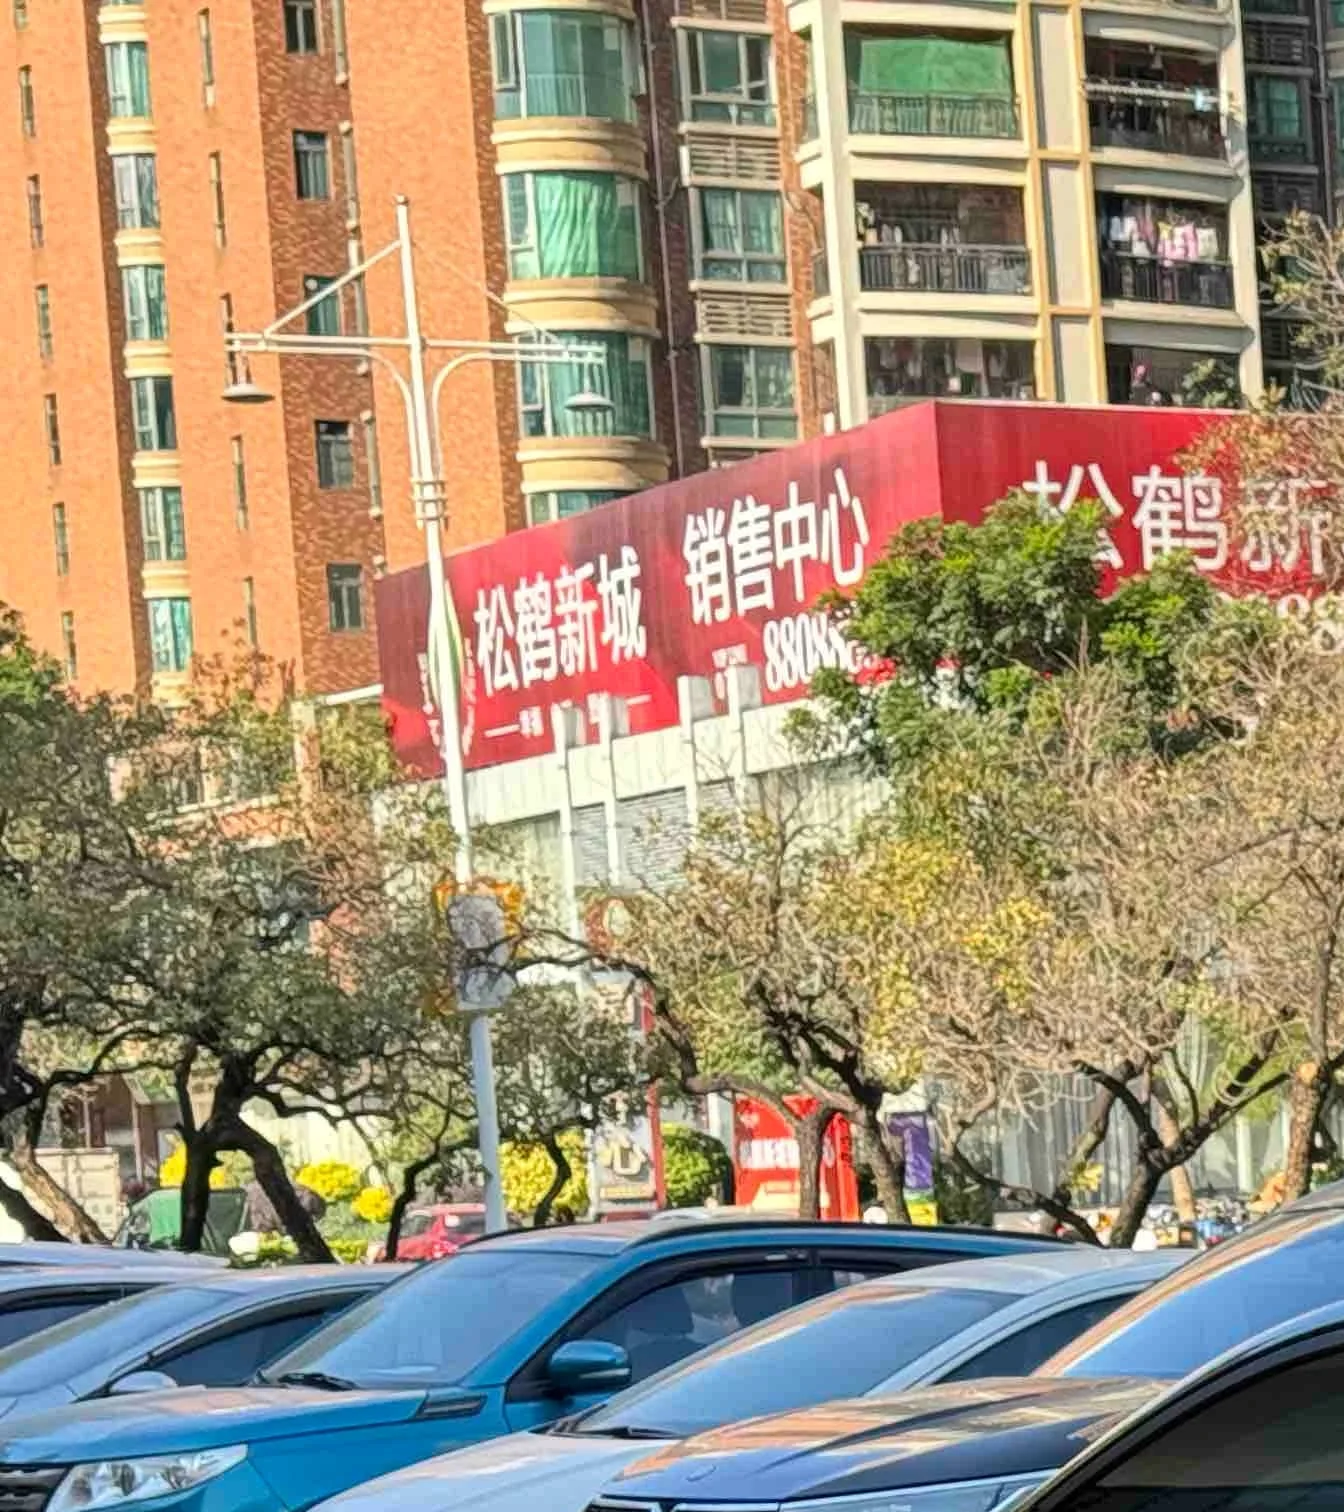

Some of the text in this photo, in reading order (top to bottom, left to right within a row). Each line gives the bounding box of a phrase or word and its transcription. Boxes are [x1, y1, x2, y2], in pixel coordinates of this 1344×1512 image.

[474, 467, 868, 697] 松鹤新城 销售中心
